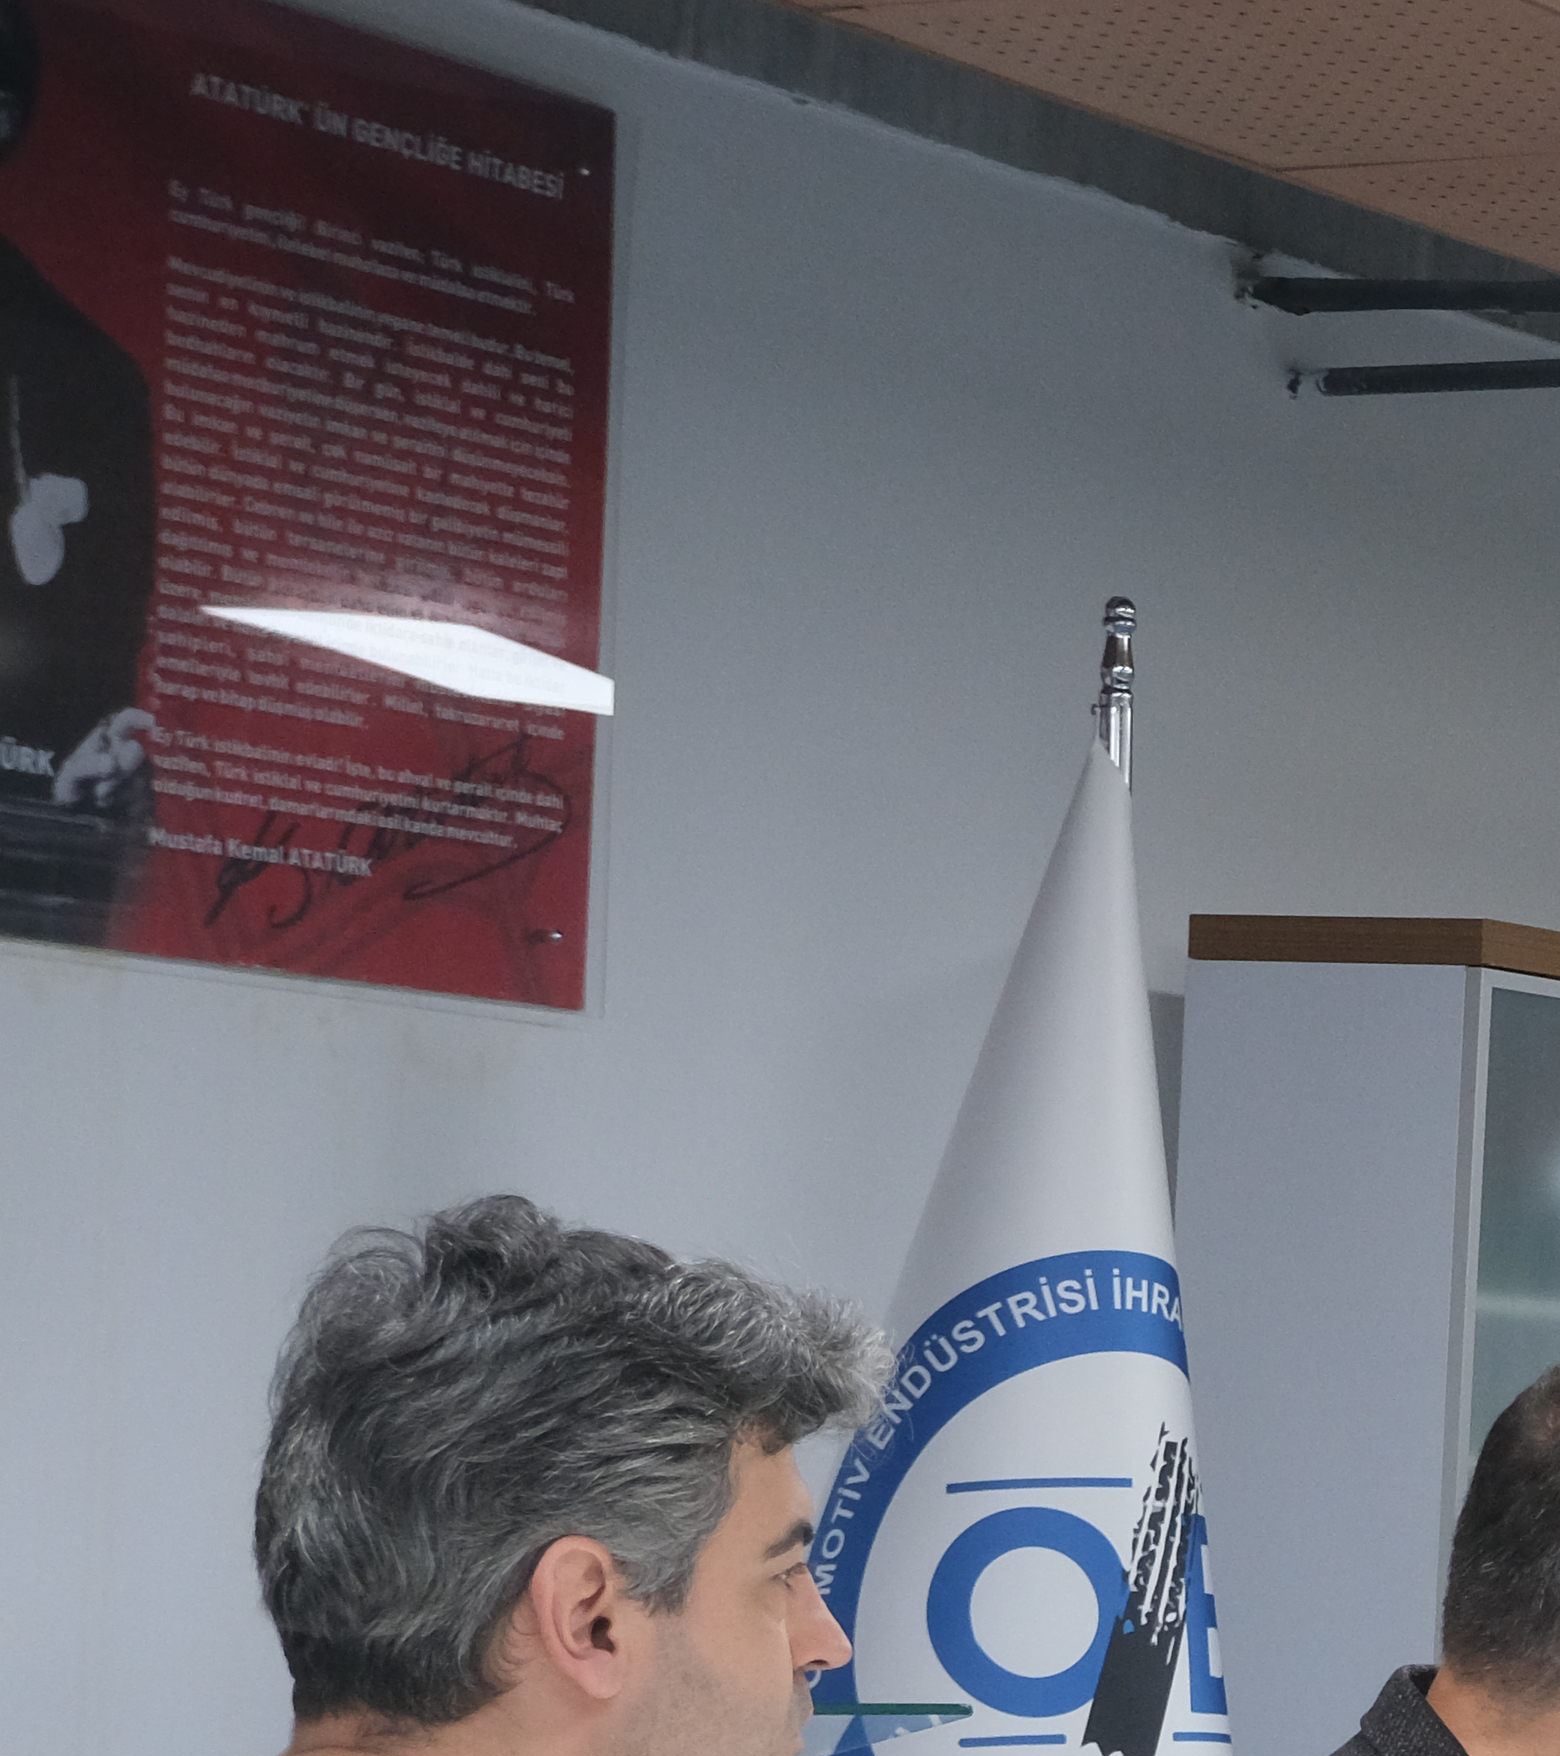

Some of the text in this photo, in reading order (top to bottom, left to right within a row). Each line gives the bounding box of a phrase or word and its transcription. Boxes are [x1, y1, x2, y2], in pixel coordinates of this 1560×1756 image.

[353, 117, 463, 171] GENÇLİĞE
[467, 150, 564, 199] HİTABESİ
[288, 848, 373, 877] ATATÜRK
[866, 1268, 1100, 1450] ENDÜSTRİSİ
